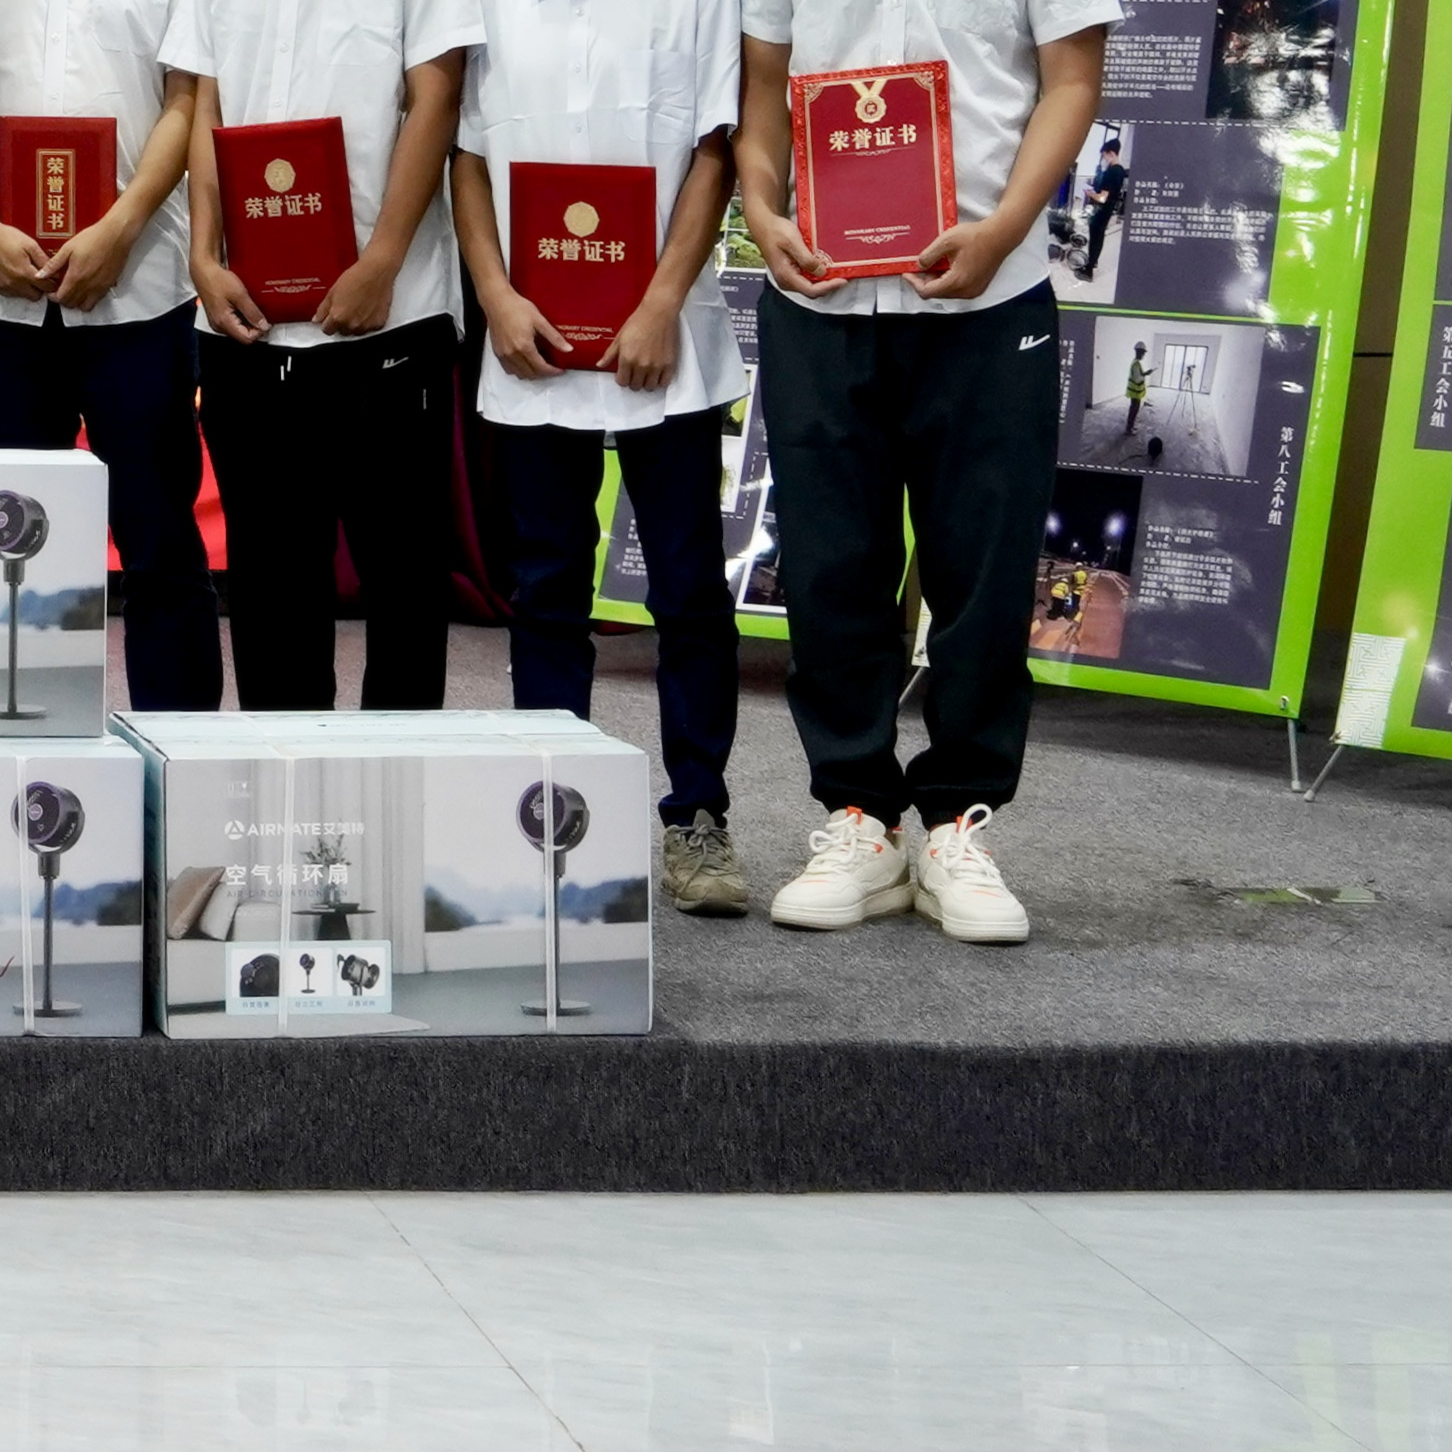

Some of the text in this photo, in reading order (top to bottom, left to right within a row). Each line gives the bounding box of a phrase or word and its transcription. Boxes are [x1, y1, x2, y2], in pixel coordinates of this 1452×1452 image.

[829, 124, 918, 151] 荣誉证书
[47, 157, 65, 230] 荣誉证书
[245, 192, 323, 219] 荣誉证书
[538, 238, 626, 263] 荣誉证书
[1267, 426, 1295, 526] 第八工会小组
